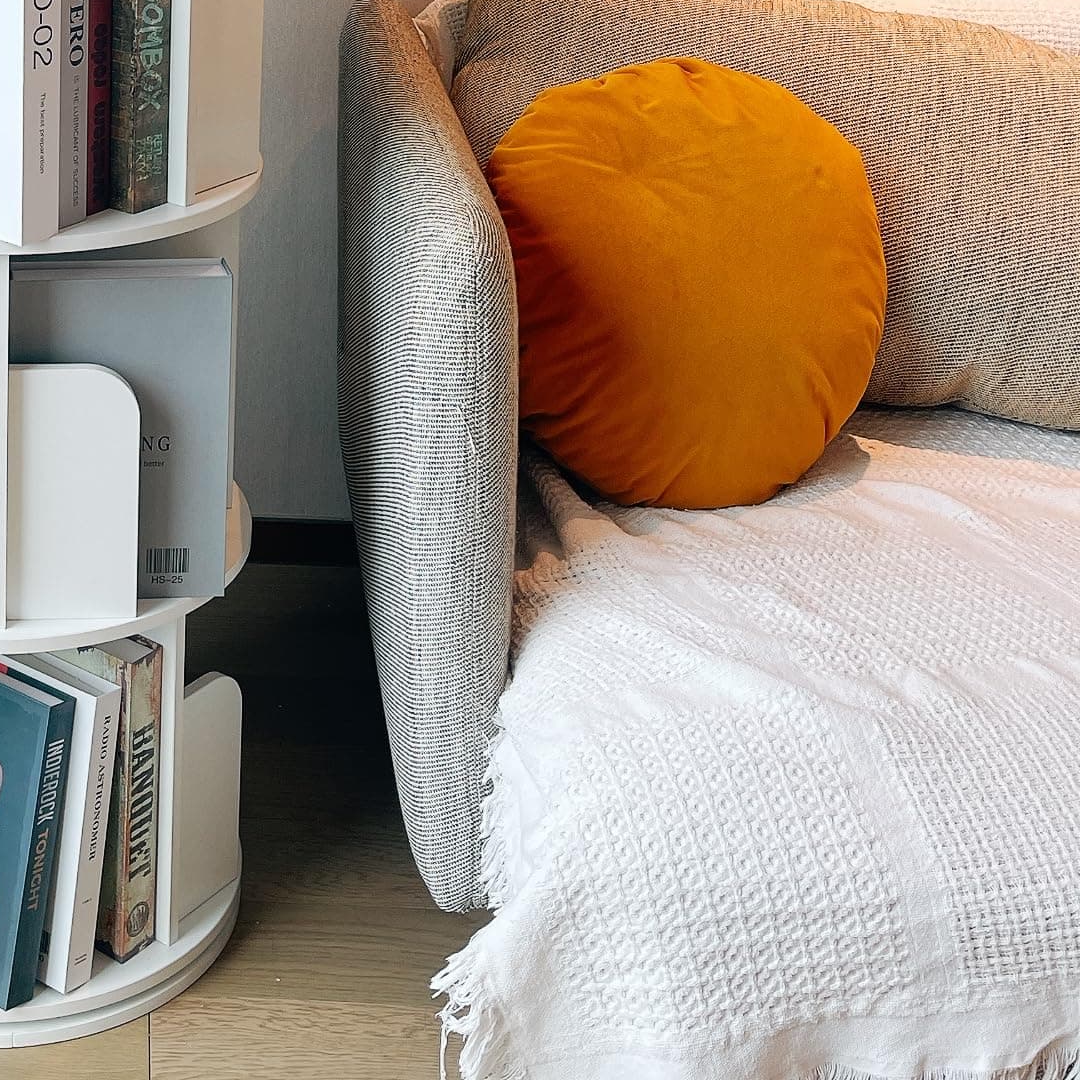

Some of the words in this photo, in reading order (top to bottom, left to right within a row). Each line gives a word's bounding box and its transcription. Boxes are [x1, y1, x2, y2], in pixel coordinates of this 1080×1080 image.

[38, 129, 47, 175] preparation
[143, 460, 165, 468] better
[151, 575, 184, 585] HS-25
[99, 714, 112, 760] RADIO
[37, 738, 66, 826] INDIEROCK
[87, 765, 106, 863] ASTRONOMER
[128, 720, 156, 883] BANQUET
[23, 827, 50, 912] TONIGHT
